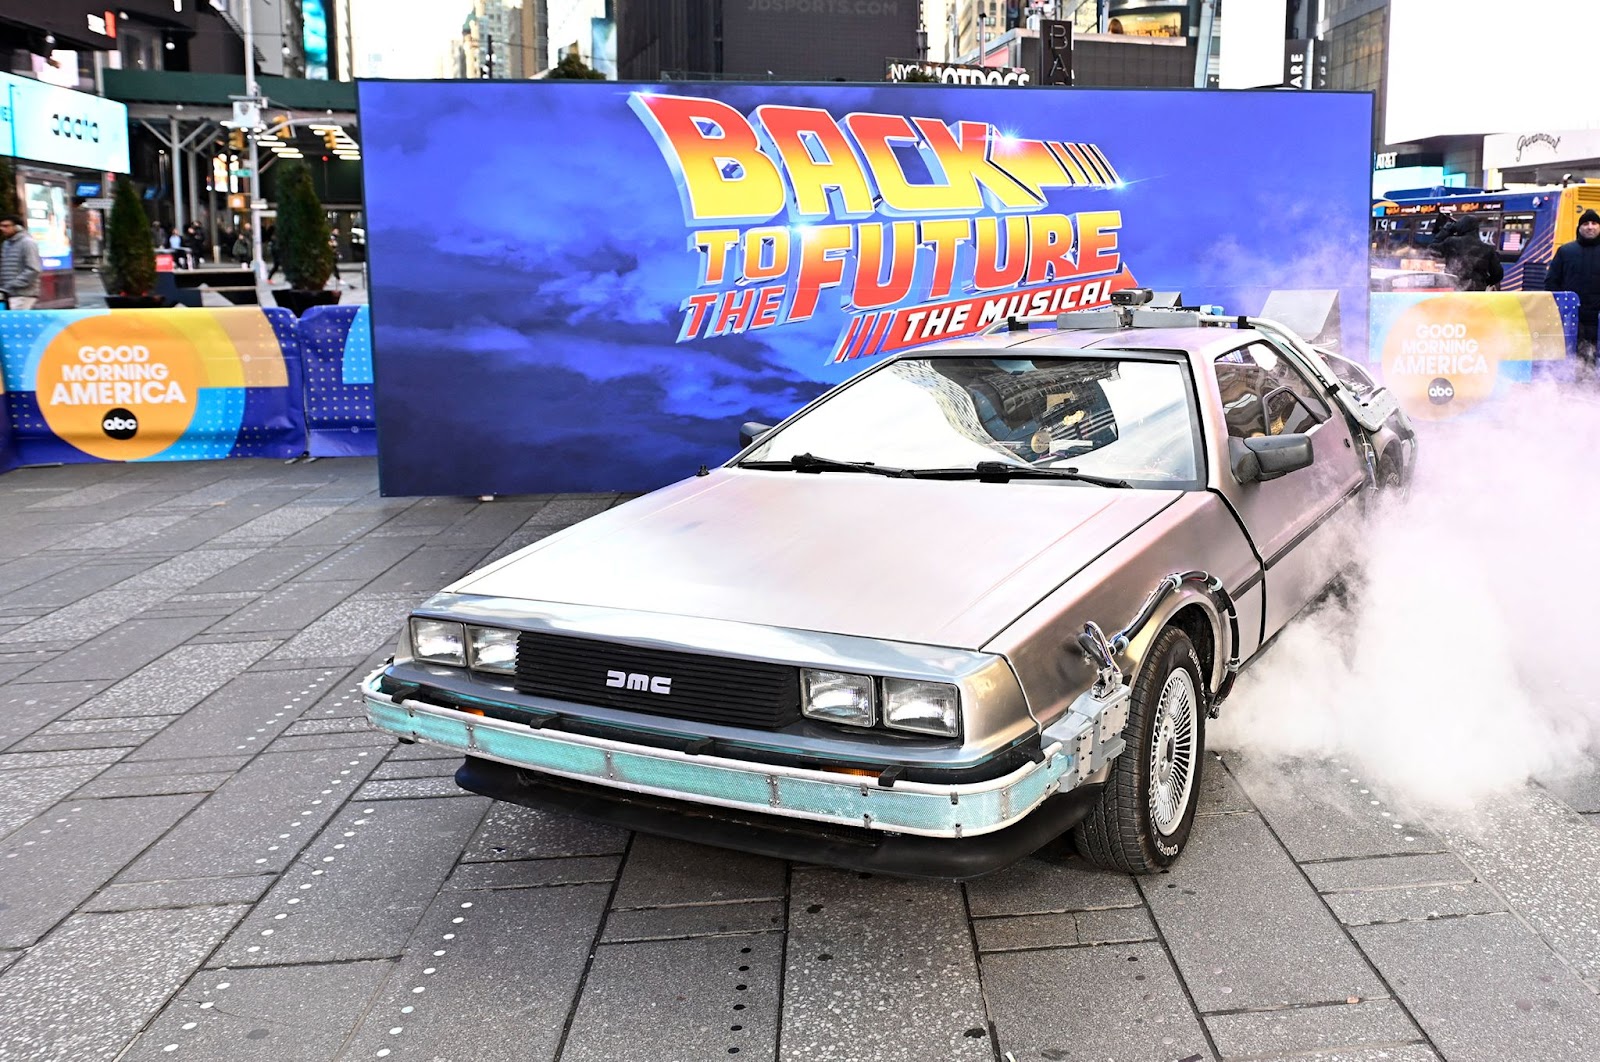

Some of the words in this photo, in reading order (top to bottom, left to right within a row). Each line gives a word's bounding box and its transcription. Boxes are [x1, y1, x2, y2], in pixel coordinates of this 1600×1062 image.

[1050, 25, 1068, 86] BA
[628, 92, 1047, 224] BACK
[1516, 133, 1561, 162] Paramount
[1376, 152, 1398, 169] AT&T
[690, 227, 791, 287] TO
[787, 210, 1124, 322] FUTURE
[678, 287, 787, 343] THE
[902, 306, 967, 342] THE
[976, 279, 1115, 328] MUSICAL
[1416, 323, 1467, 339] GOOD
[78, 345, 149, 363] GOOD
[1402, 339, 1479, 355] MORNING
[62, 363, 169, 381] MORNING
[1391, 355, 1489, 375] AMERICA
[50, 380, 187, 405] AMERICA
[1428, 384, 1454, 397] abc
[103, 416, 138, 431] abc
